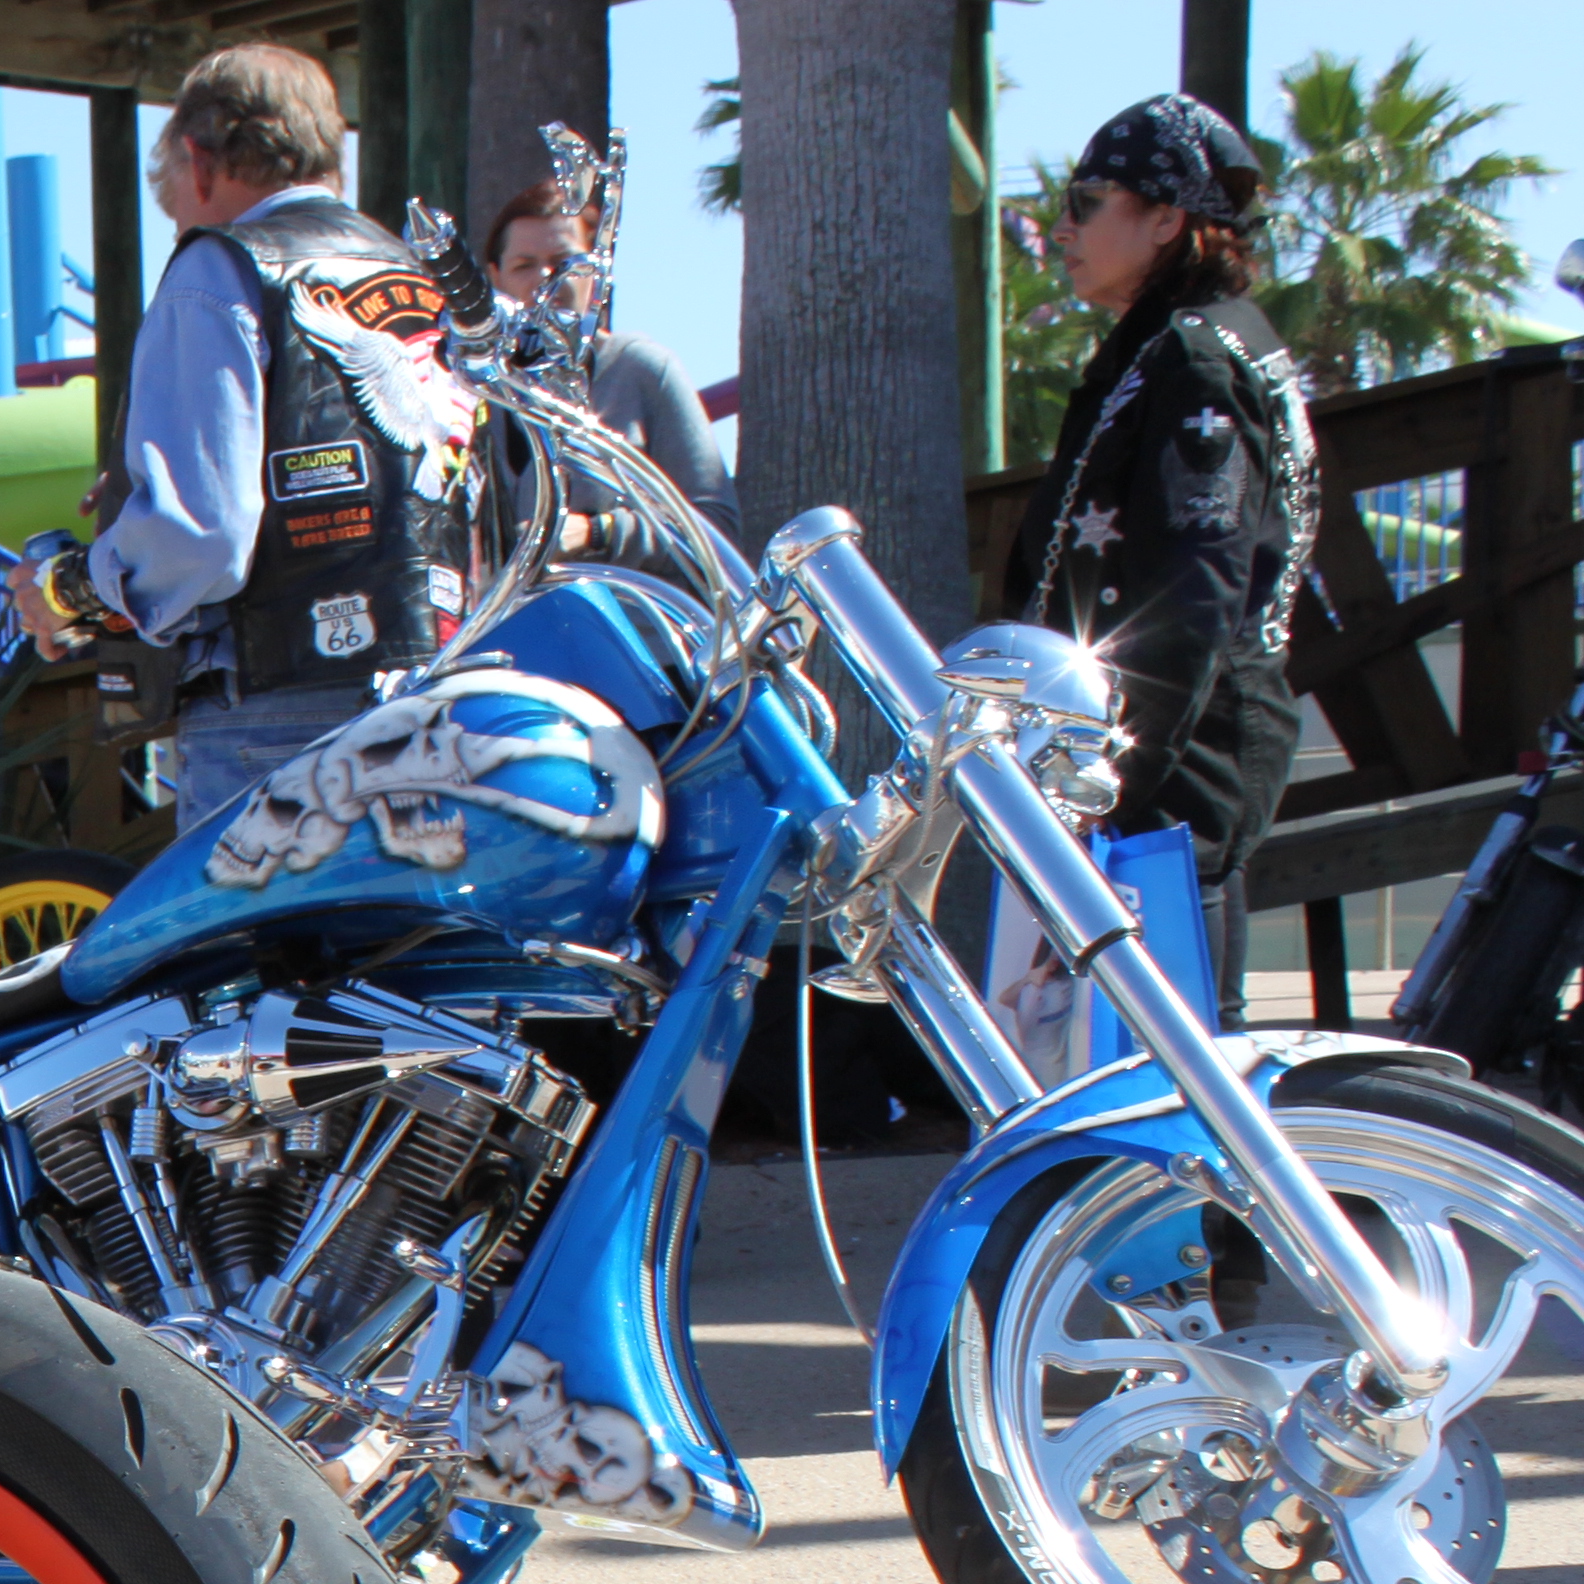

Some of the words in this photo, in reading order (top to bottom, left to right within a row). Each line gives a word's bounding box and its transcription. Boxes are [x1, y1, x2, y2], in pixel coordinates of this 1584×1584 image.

[353, 290, 392, 323] LIVE
[388, 284, 413, 305] TO
[284, 449, 352, 471] CAUTION
[317, 599, 362, 618] ROUTE
[327, 627, 362, 652] 66
